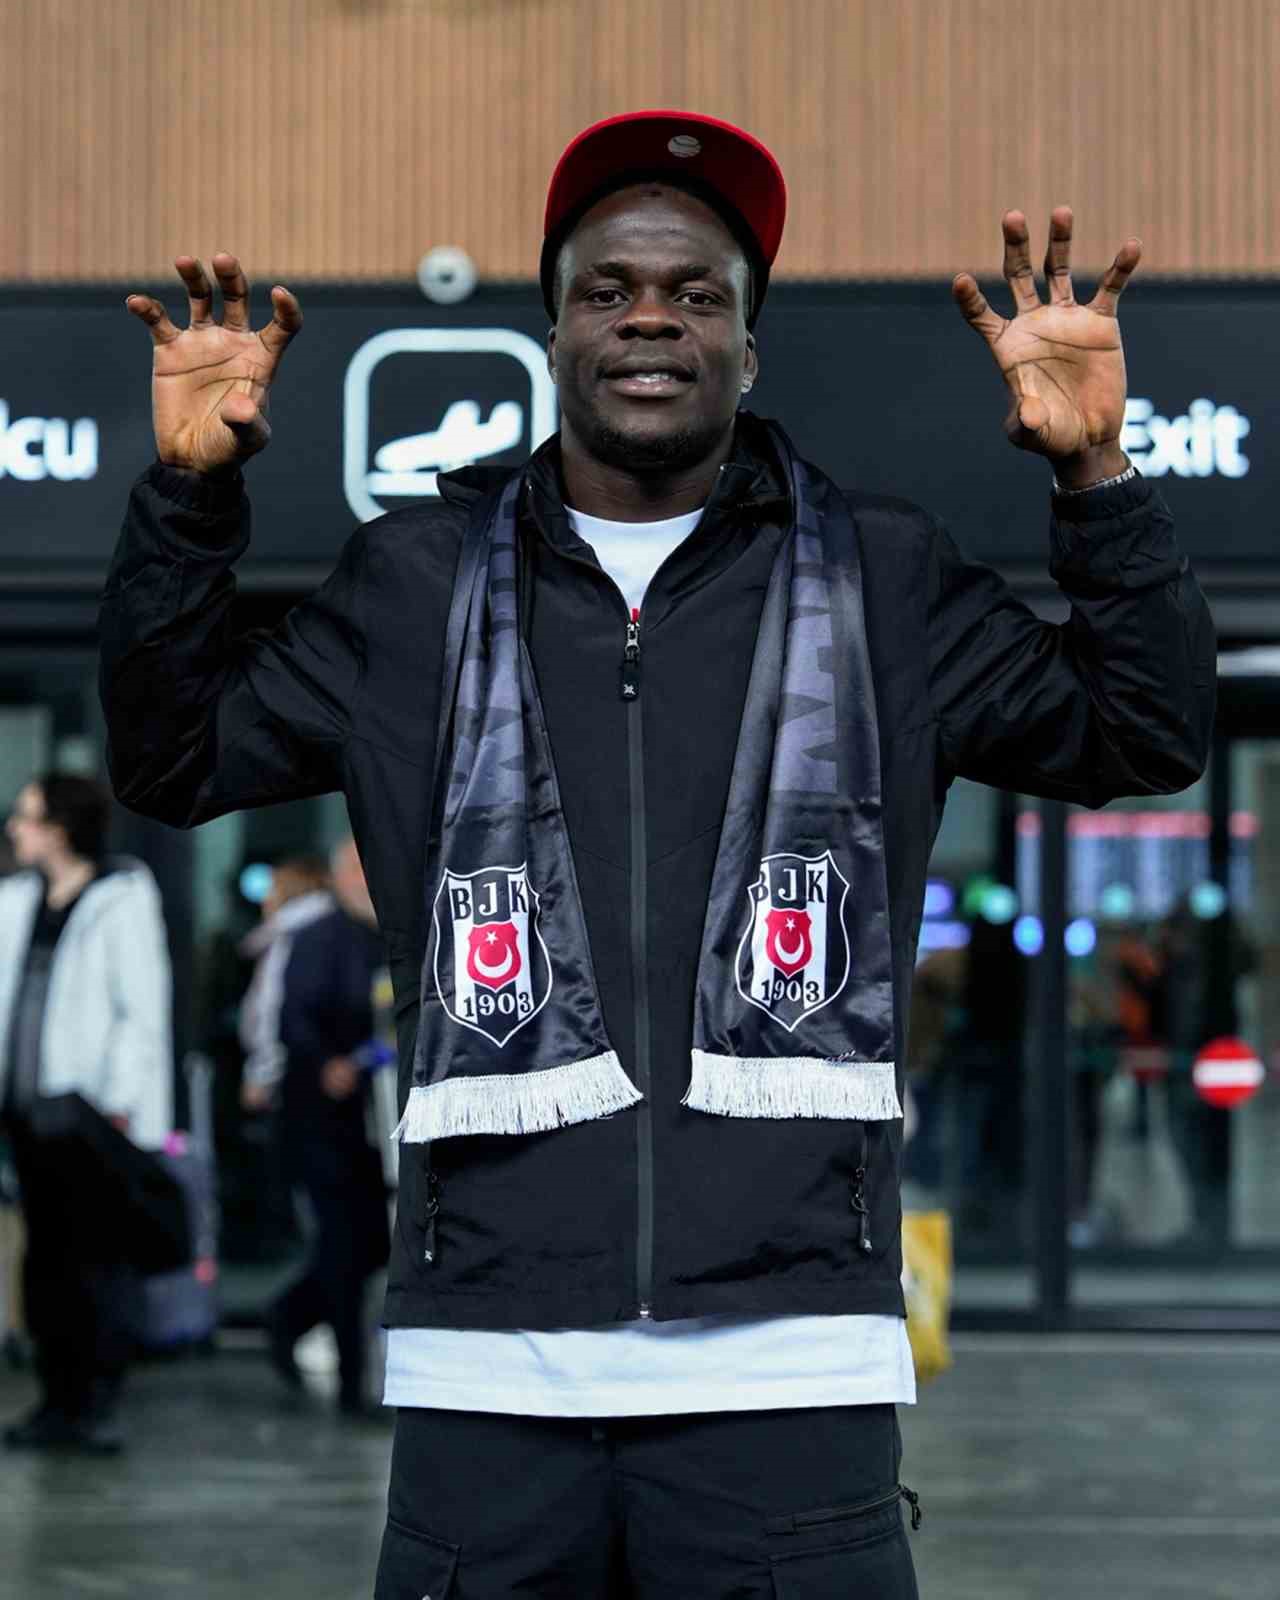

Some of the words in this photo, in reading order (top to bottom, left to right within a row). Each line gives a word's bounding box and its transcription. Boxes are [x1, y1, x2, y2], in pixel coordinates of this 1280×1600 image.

[1120, 398, 1250, 478] Exit
[450, 880, 528, 920] BJK
[754, 868, 825, 904] BJK
[463, 991, 532, 1018] 1903
[761, 979, 820, 1003] 1903
